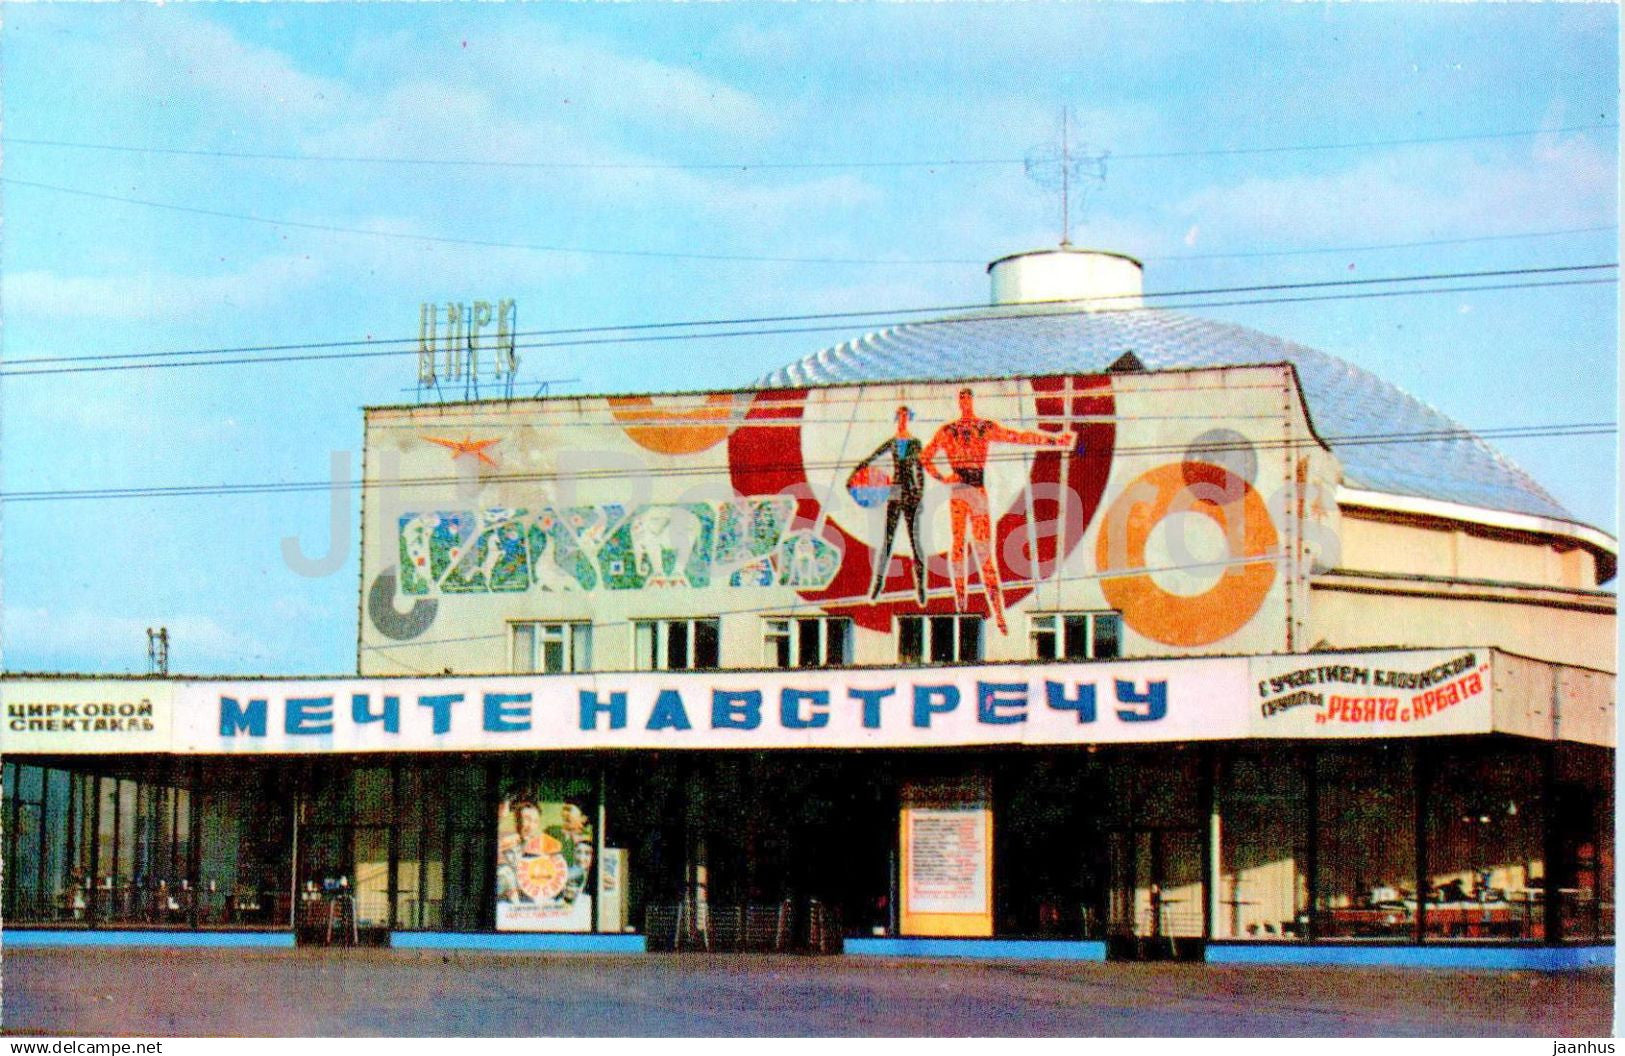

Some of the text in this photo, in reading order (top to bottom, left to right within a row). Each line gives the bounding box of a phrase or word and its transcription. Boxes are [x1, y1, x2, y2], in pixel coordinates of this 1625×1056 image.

[419, 300, 519, 387] ЦИРК
[1270, 665, 1370, 693] УЧАСТИЕМ
[8, 698, 153, 718] ЦИРКОВОЙ
[220, 681, 1168, 737] МЕЧТЕ НАВСТРЕЧУ
[9, 718, 154, 732] СПЕКТАКЛЬ
